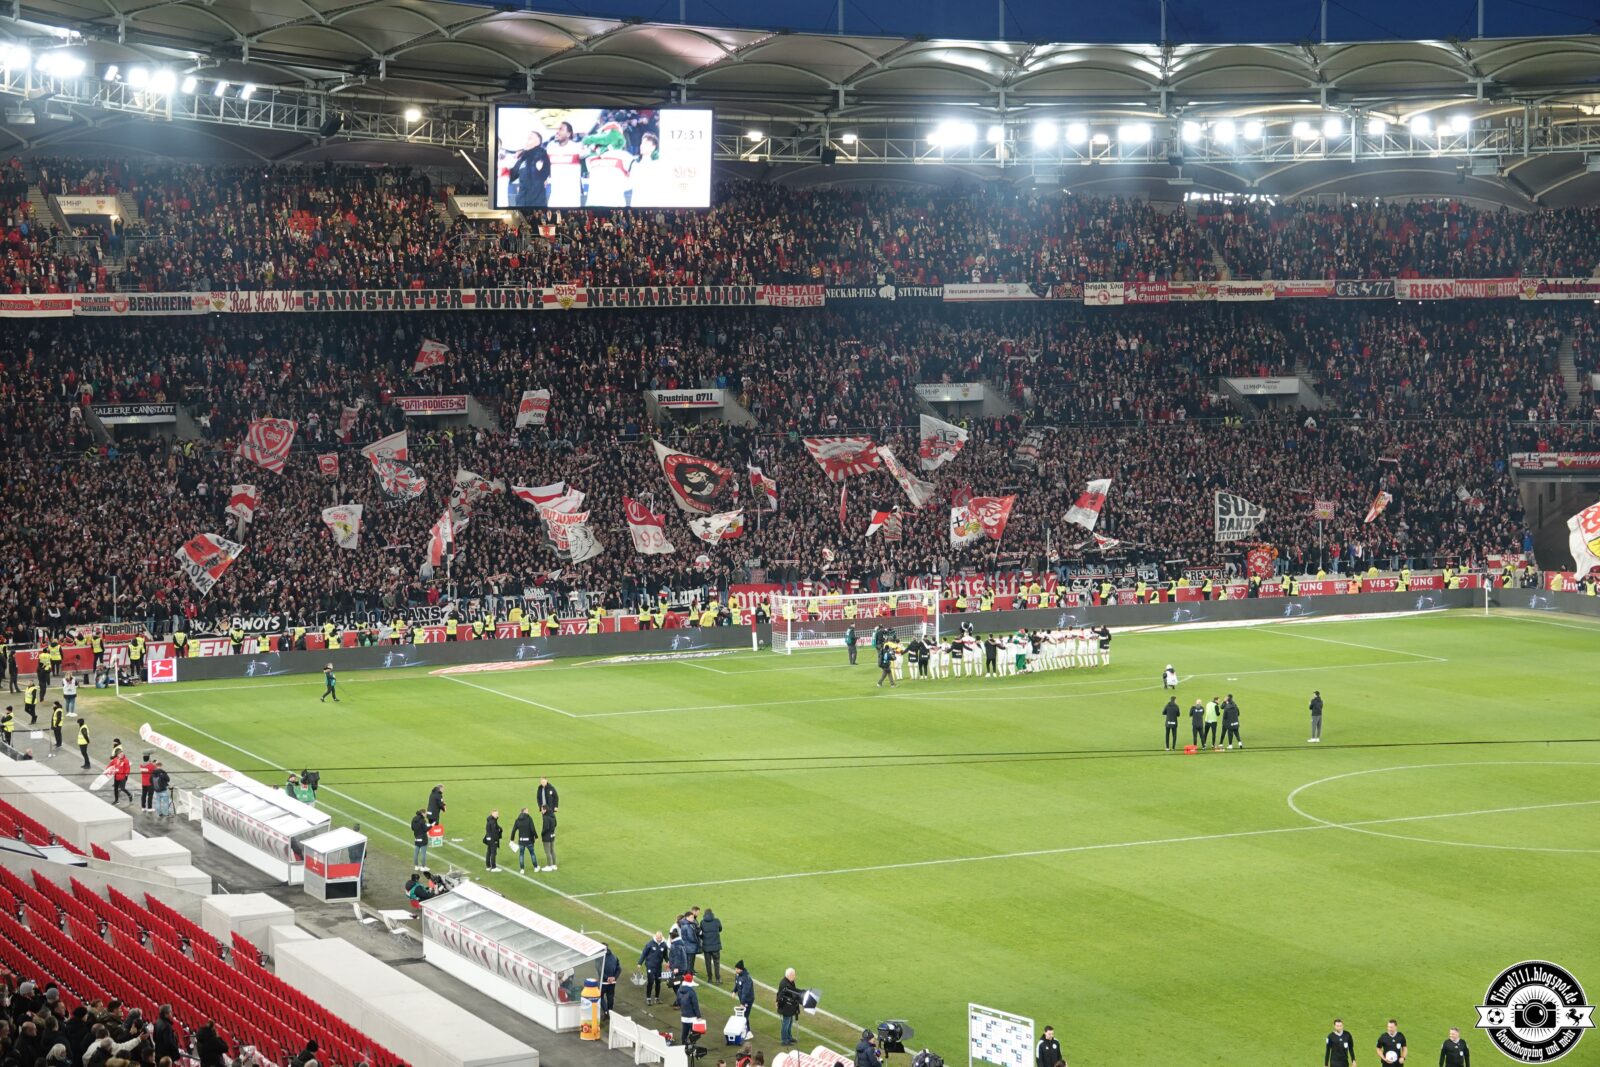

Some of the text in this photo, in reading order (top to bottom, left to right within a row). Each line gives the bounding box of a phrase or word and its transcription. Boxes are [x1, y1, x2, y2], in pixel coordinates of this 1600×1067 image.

[670, 129, 703, 139] 17:31
[765, 284, 823, 295] ALBSTADT
[825, 287, 876, 299] NECKAR-FILS
[898, 286, 944, 298] STUTTGART
[1455, 283, 1486, 297] DONAU
[229, 290, 252, 312] Red
[303, 288, 543, 312] CANNSTATTER KURVE
[586, 286, 757, 307] NECKARSTADION
[767, 295, 822, 306] VFB-FANS
[128, 296, 193, 312] BERKHEIM
[658, 393, 713, 403] Brustring 0711
[132, 405, 174, 414] CANNSTATT
[233, 616, 280, 631] BWOYS
[797, 639, 829, 647] WINAMAX
